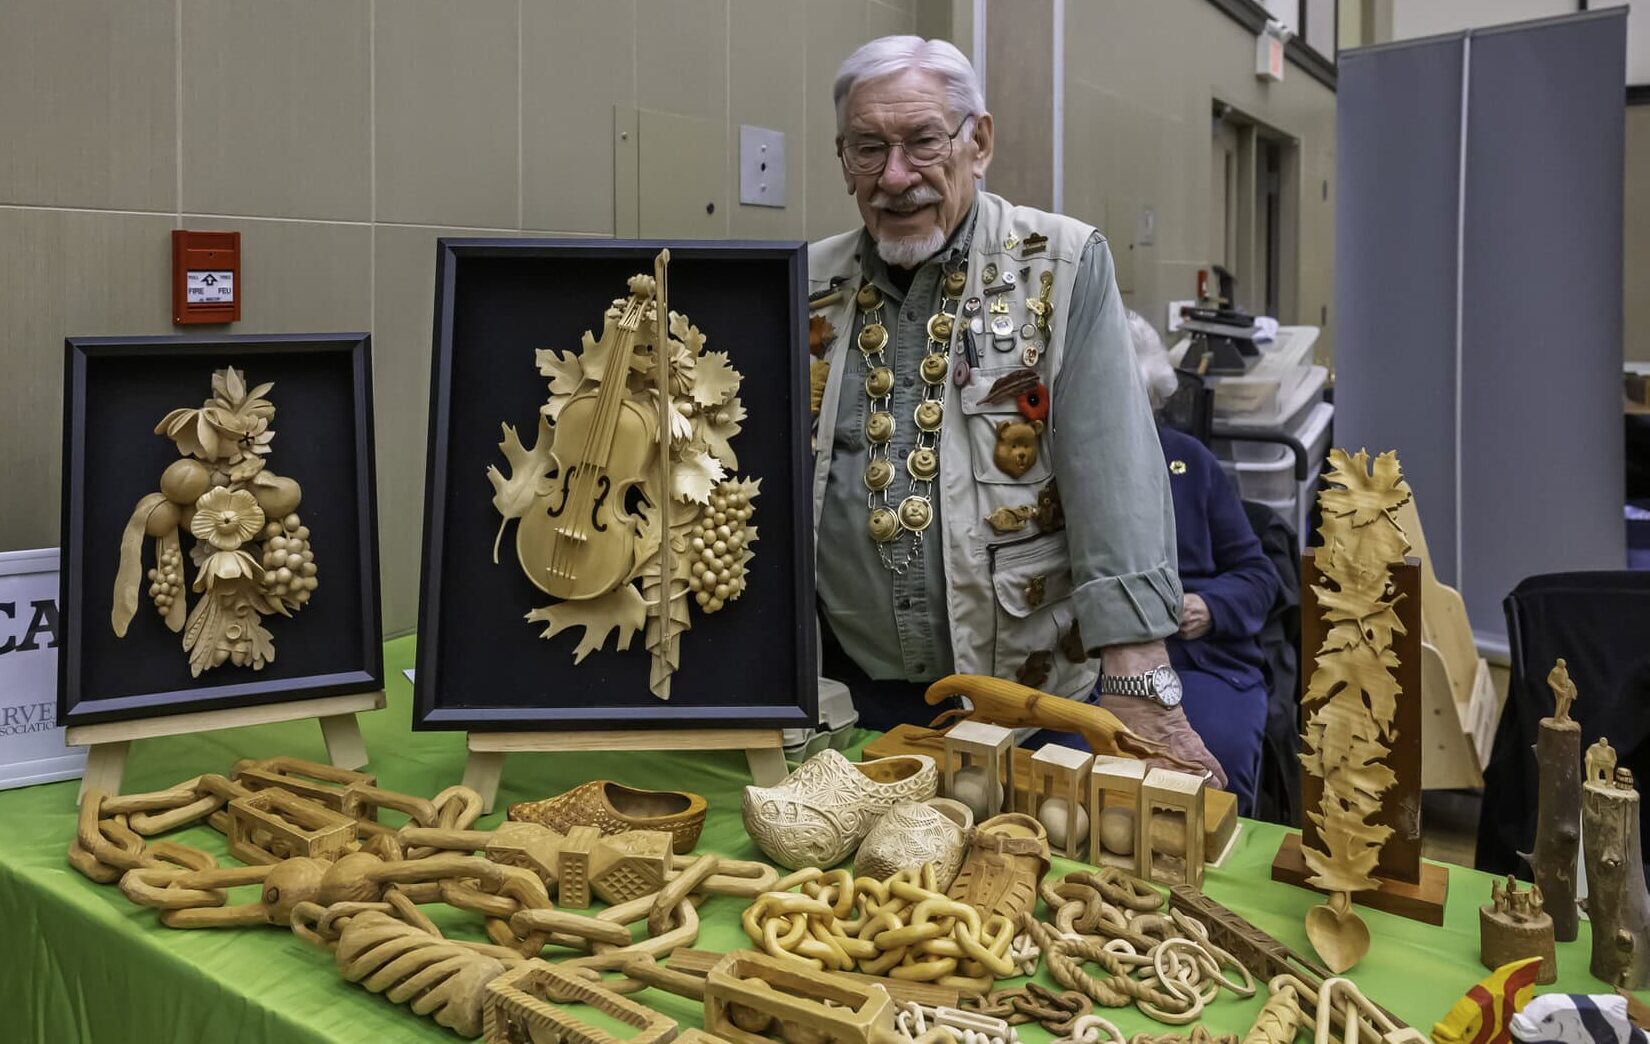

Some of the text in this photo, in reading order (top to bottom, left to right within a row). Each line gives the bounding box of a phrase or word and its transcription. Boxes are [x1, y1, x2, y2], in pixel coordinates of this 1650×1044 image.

[188, 287, 231, 295] FIRE FEU
[0, 702, 55, 725] RVE
